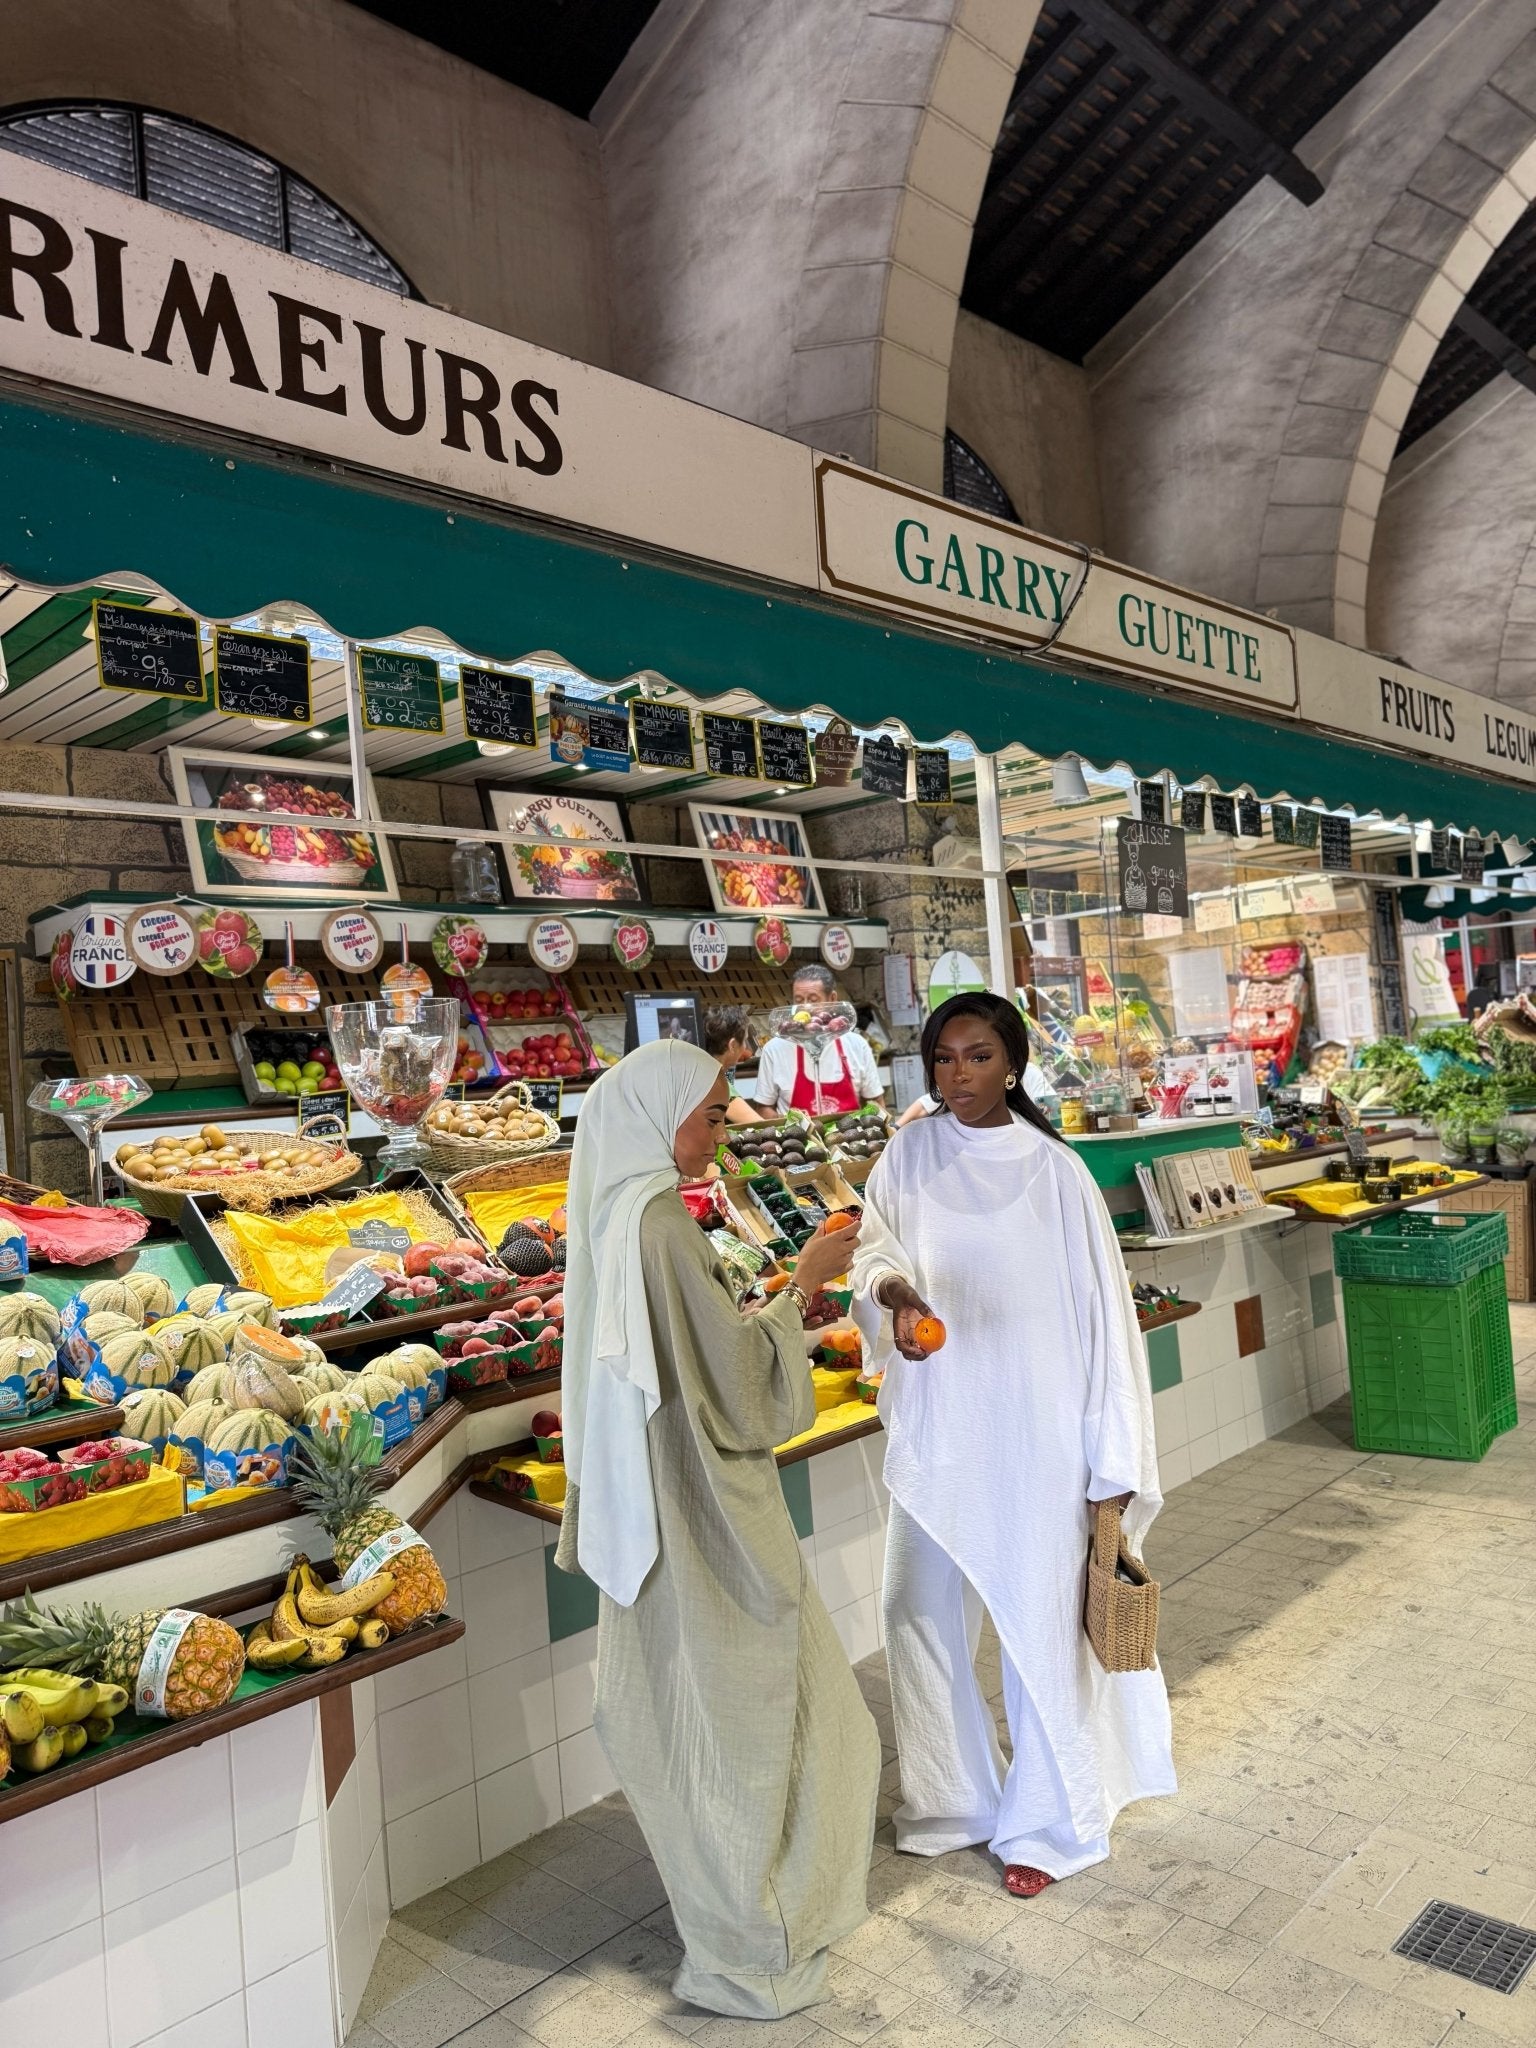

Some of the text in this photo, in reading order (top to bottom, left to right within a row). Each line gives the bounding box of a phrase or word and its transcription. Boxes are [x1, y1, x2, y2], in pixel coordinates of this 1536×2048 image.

[895, 519, 1262, 683] GARRY GUETTE
[644, 704, 690, 722] MANGUE
[1379, 676, 1455, 743] FRUITS
[556, 797, 614, 840] GUETTE
[81, 934, 121, 949] Origine
[692, 944, 726, 954] FRANCE
[246, 1278, 258, 1290] 1kg
